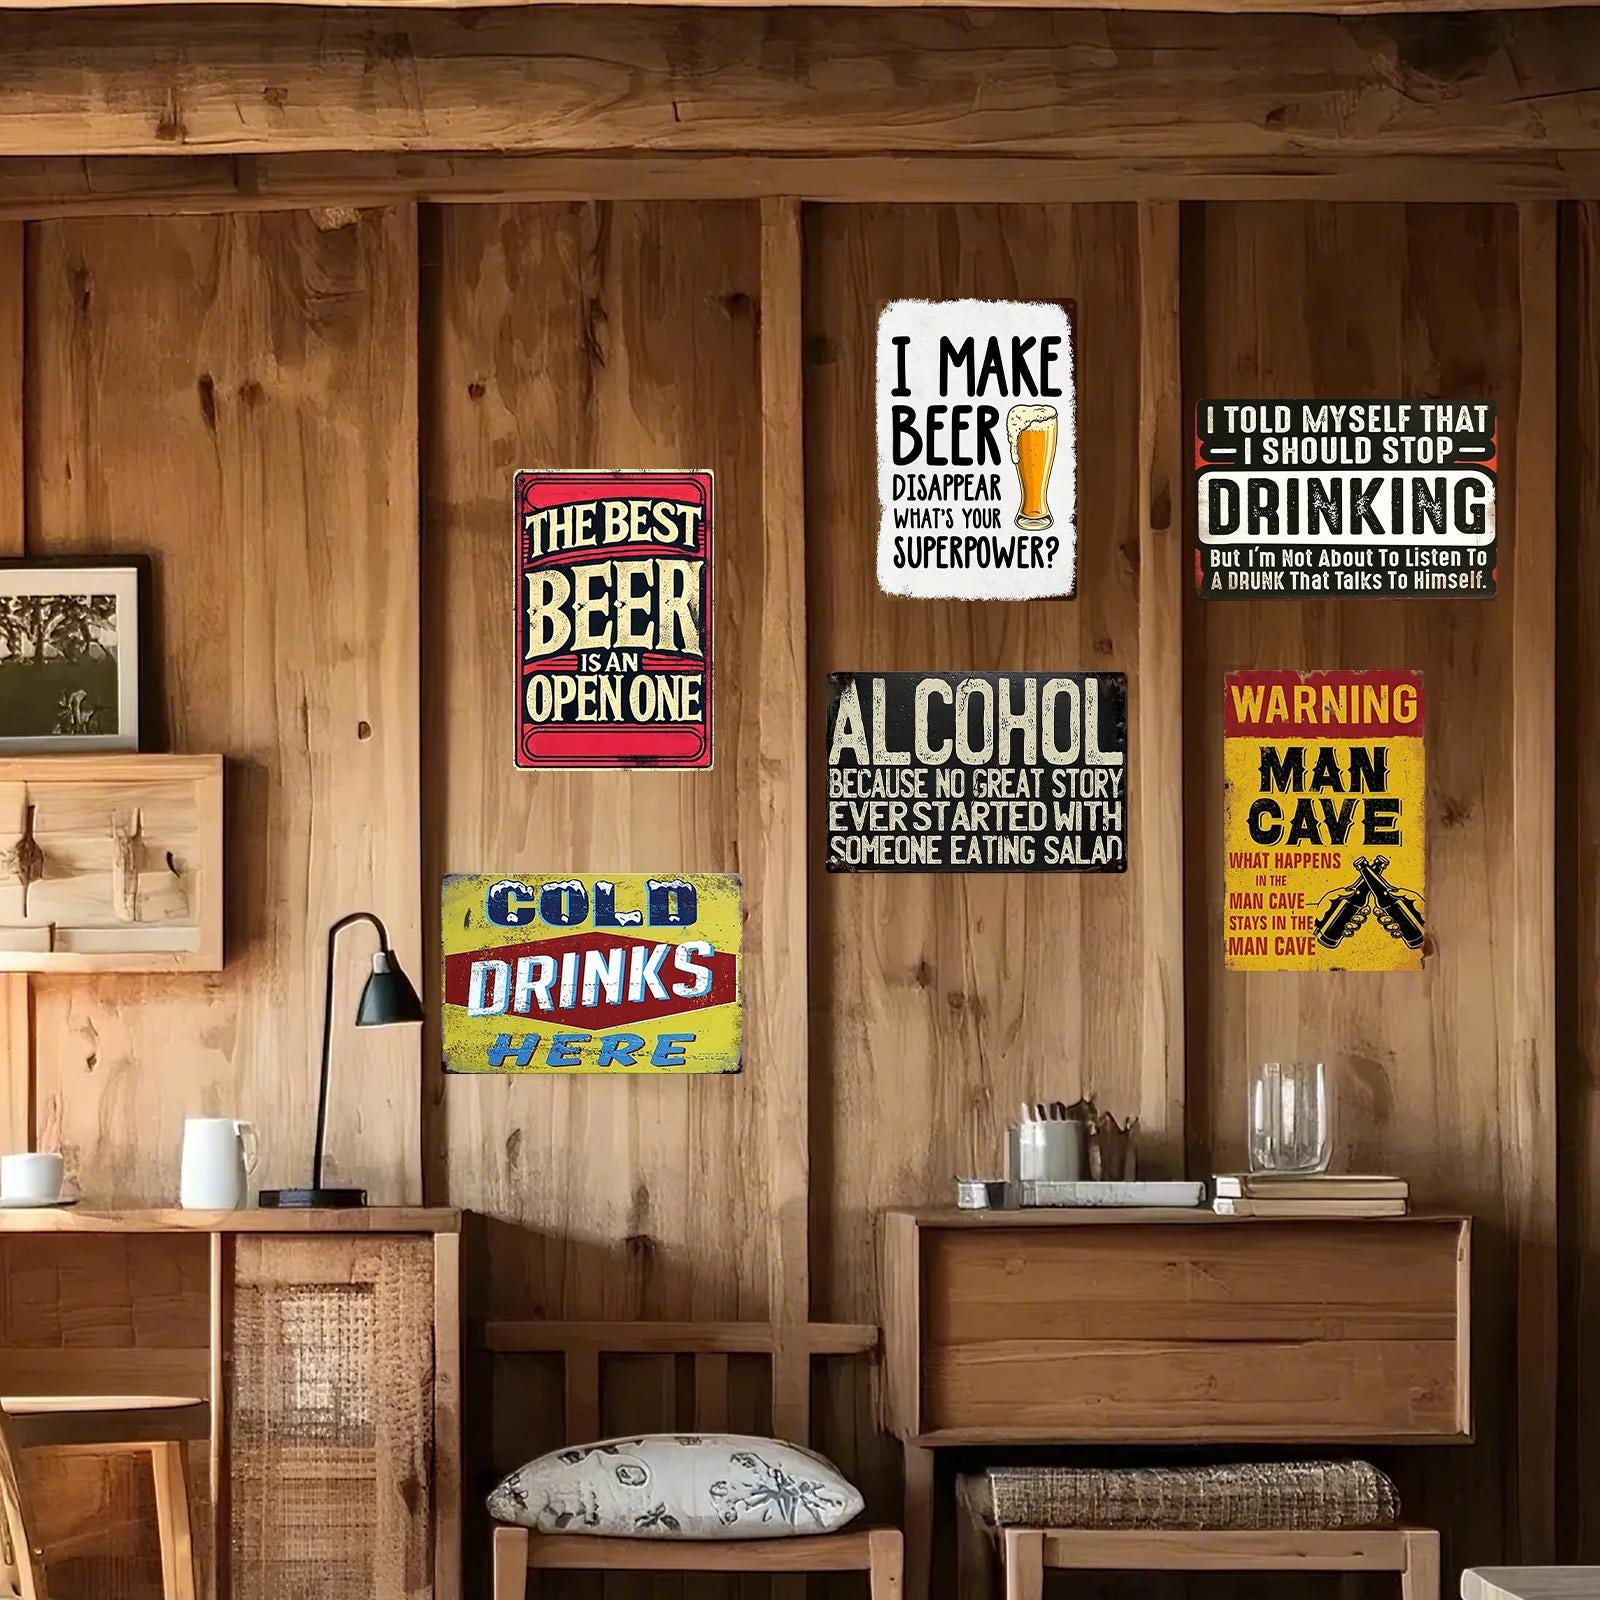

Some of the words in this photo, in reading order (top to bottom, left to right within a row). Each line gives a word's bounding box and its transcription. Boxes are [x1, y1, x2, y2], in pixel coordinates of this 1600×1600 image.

[891, 336, 911, 397] I
[940, 336, 1062, 397] MAKE
[1207, 406, 1213, 433] I
[1224, 405, 1290, 433] TOLD
[1303, 405, 1411, 433] MYSELF
[1420, 405, 1489, 432] THAT
[892, 405, 1001, 466] BEER
[1245, 437, 1251, 465] I
[1263, 437, 1371, 464] SHOULD
[1383, 436, 1453, 464] STOP
[893, 474, 1001, 501] DISAPPEAR
[894, 508, 954, 528] WHAT'S
[962, 508, 1001, 529] YOUR
[1208, 477, 1486, 536] DRINKING
[525, 502, 598, 558] THE
[602, 500, 702, 547] BEST
[894, 536, 1059, 569] SUPERPOWER?
[1211, 549, 1240, 568] But
[1249, 546, 1275, 568] I'm
[1283, 549, 1312, 567] Not
[1319, 549, 1373, 567] About
[1379, 549, 1399, 567] To
[1405, 549, 1461, 566] Listen
[1467, 548, 1487, 566] To
[1211, 572, 1222, 590] A
[1229, 571, 1284, 590] DRUNK
[1290, 571, 1329, 590] That
[1335, 571, 1382, 590] Talks
[1388, 571, 1408, 590] To
[1414, 570, 1487, 589] Himself.
[525, 558, 704, 660] BEER
[581, 654, 601, 672] IS
[604, 653, 638, 672] AN
[526, 674, 624, 722] OPEN
[629, 674, 702, 722] ONE
[1231, 684, 1417, 724] WARNING
[828, 678, 1123, 765] ALCOHOL
[829, 768, 928, 798] BECAUSE
[936, 768, 964, 798] NO
[973, 768, 1044, 798] GREAT
[1051, 768, 1123, 798] STORY
[1258, 746, 1390, 794] MAN
[829, 801, 907, 831] EVER
[913, 801, 1047, 831] STARTED
[1053, 801, 1121, 831] WITH
[1246, 798, 1402, 846] CAVE
[830, 836, 942, 864] SOMEONE
[951, 836, 1035, 864] EATING
[1044, 836, 1122, 864] SALAD
[1229, 852, 1269, 869] WHAT
[1274, 852, 1341, 869] HAPPENS
[1256, 876, 1266, 886] IN
[1270, 876, 1286, 886] THE
[486, 879, 698, 928] COLD
[1230, 893, 1264, 909] MAN
[1269, 893, 1304, 909] CAVE
[1230, 916, 1267, 930] STAYS
[1272, 916, 1286, 930] IN
[1291, 916, 1314, 930] THE
[1229, 936, 1269, 956] MAN
[1274, 936, 1316, 956] CAVE
[468, 940, 714, 1017] DRINKS
[487, 1033, 696, 1067] HERE
